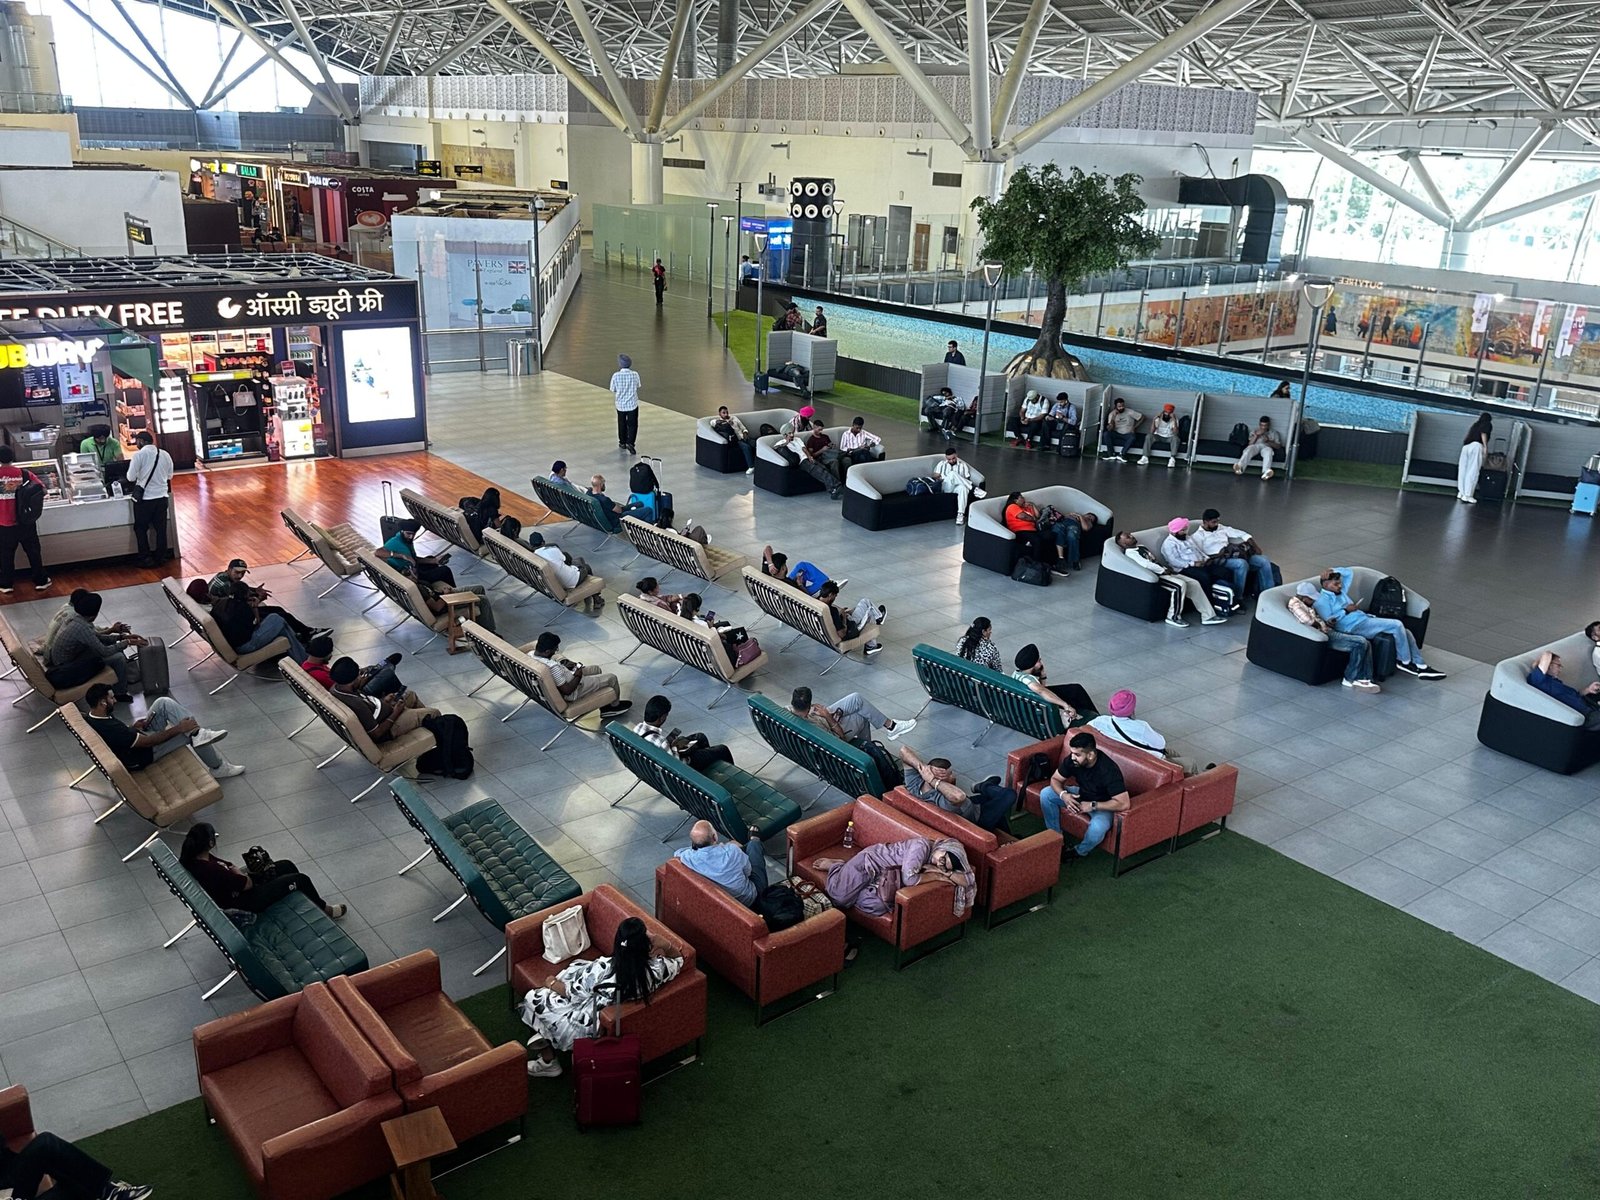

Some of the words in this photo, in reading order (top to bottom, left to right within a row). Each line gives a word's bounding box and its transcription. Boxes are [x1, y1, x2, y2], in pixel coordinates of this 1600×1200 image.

[119, 301, 185, 327] FREE
[246, 291, 302, 317] ऑस्प्री
[306, 288, 353, 320] ड्यूटी
[356, 287, 384, 312] फ्री
